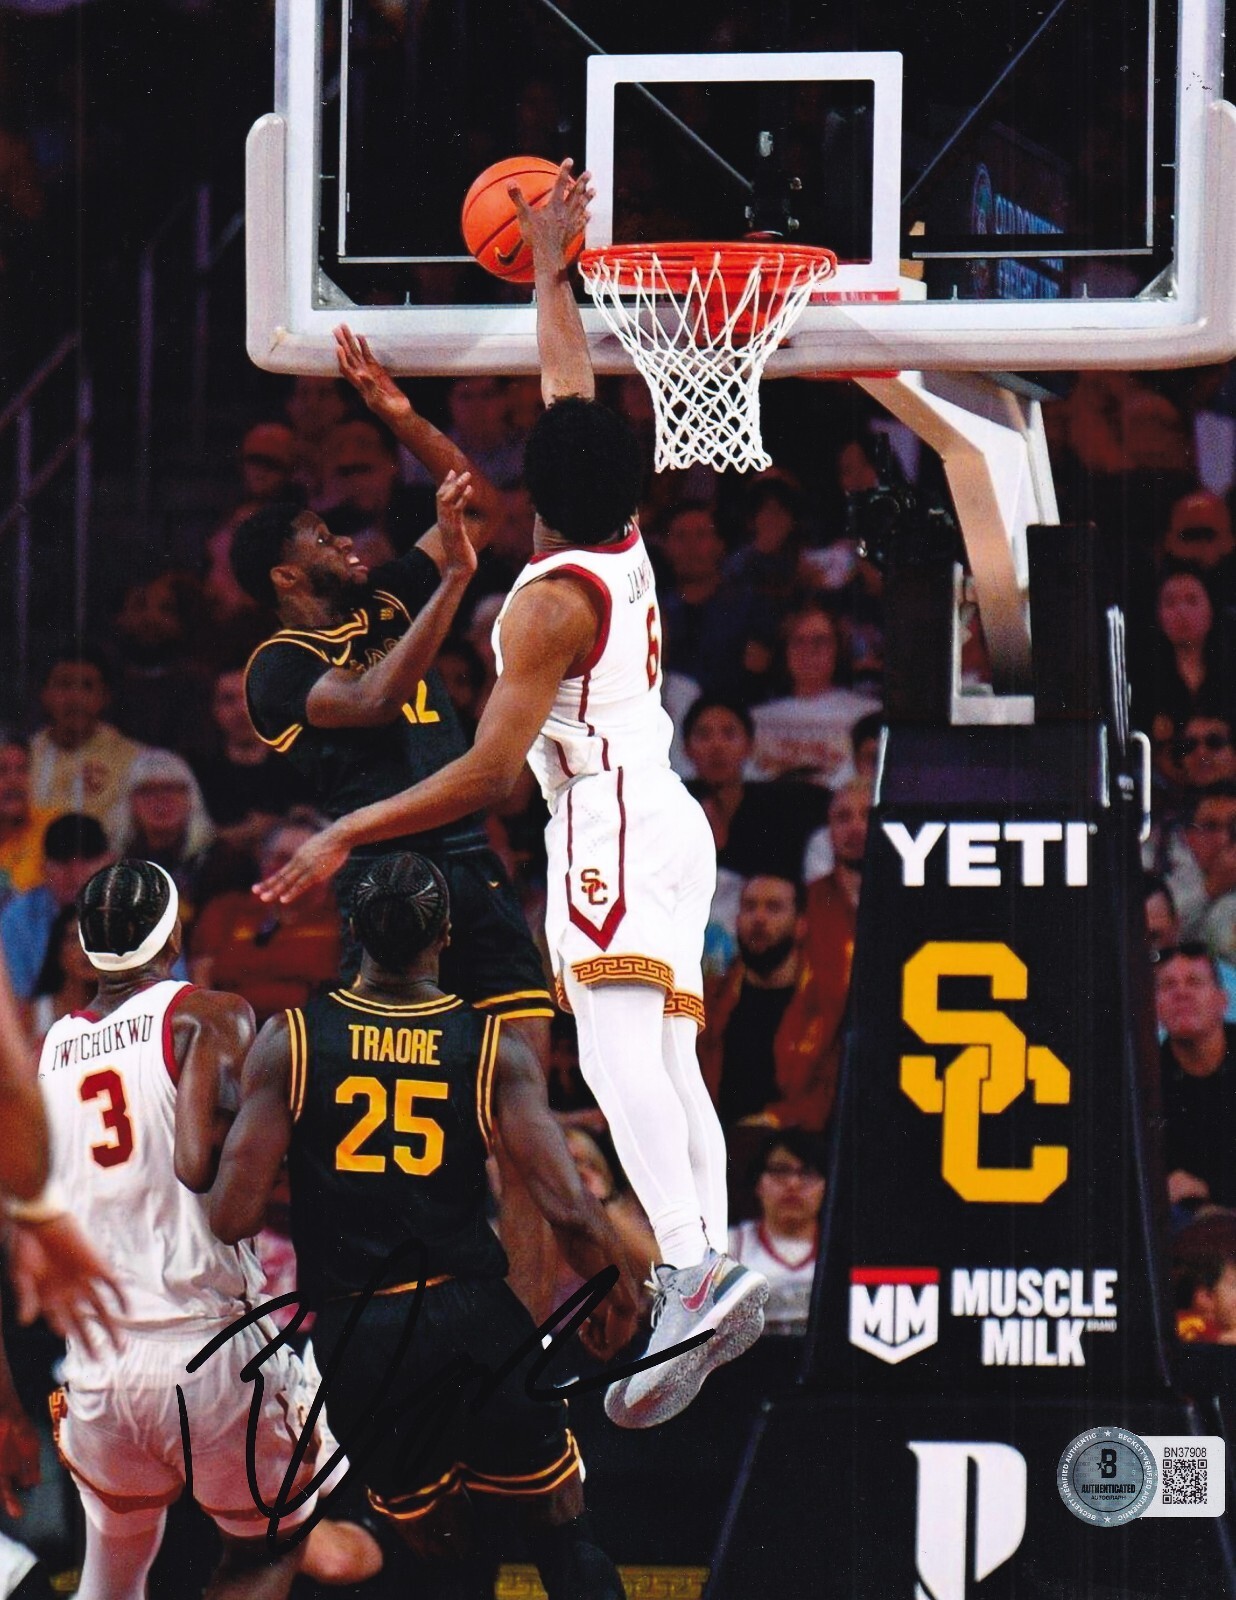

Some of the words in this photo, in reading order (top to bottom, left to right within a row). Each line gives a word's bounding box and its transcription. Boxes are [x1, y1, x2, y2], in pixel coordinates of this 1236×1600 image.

[882, 821, 1088, 887] YETI
[348, 1024, 443, 1066] TRAORE
[899, 940, 1071, 1204] SC
[79, 1068, 134, 1169] 3
[335, 1075, 449, 1177] 25
[952, 1268, 1118, 1317] MUSCLE
[982, 1318, 1086, 1367] MILK
